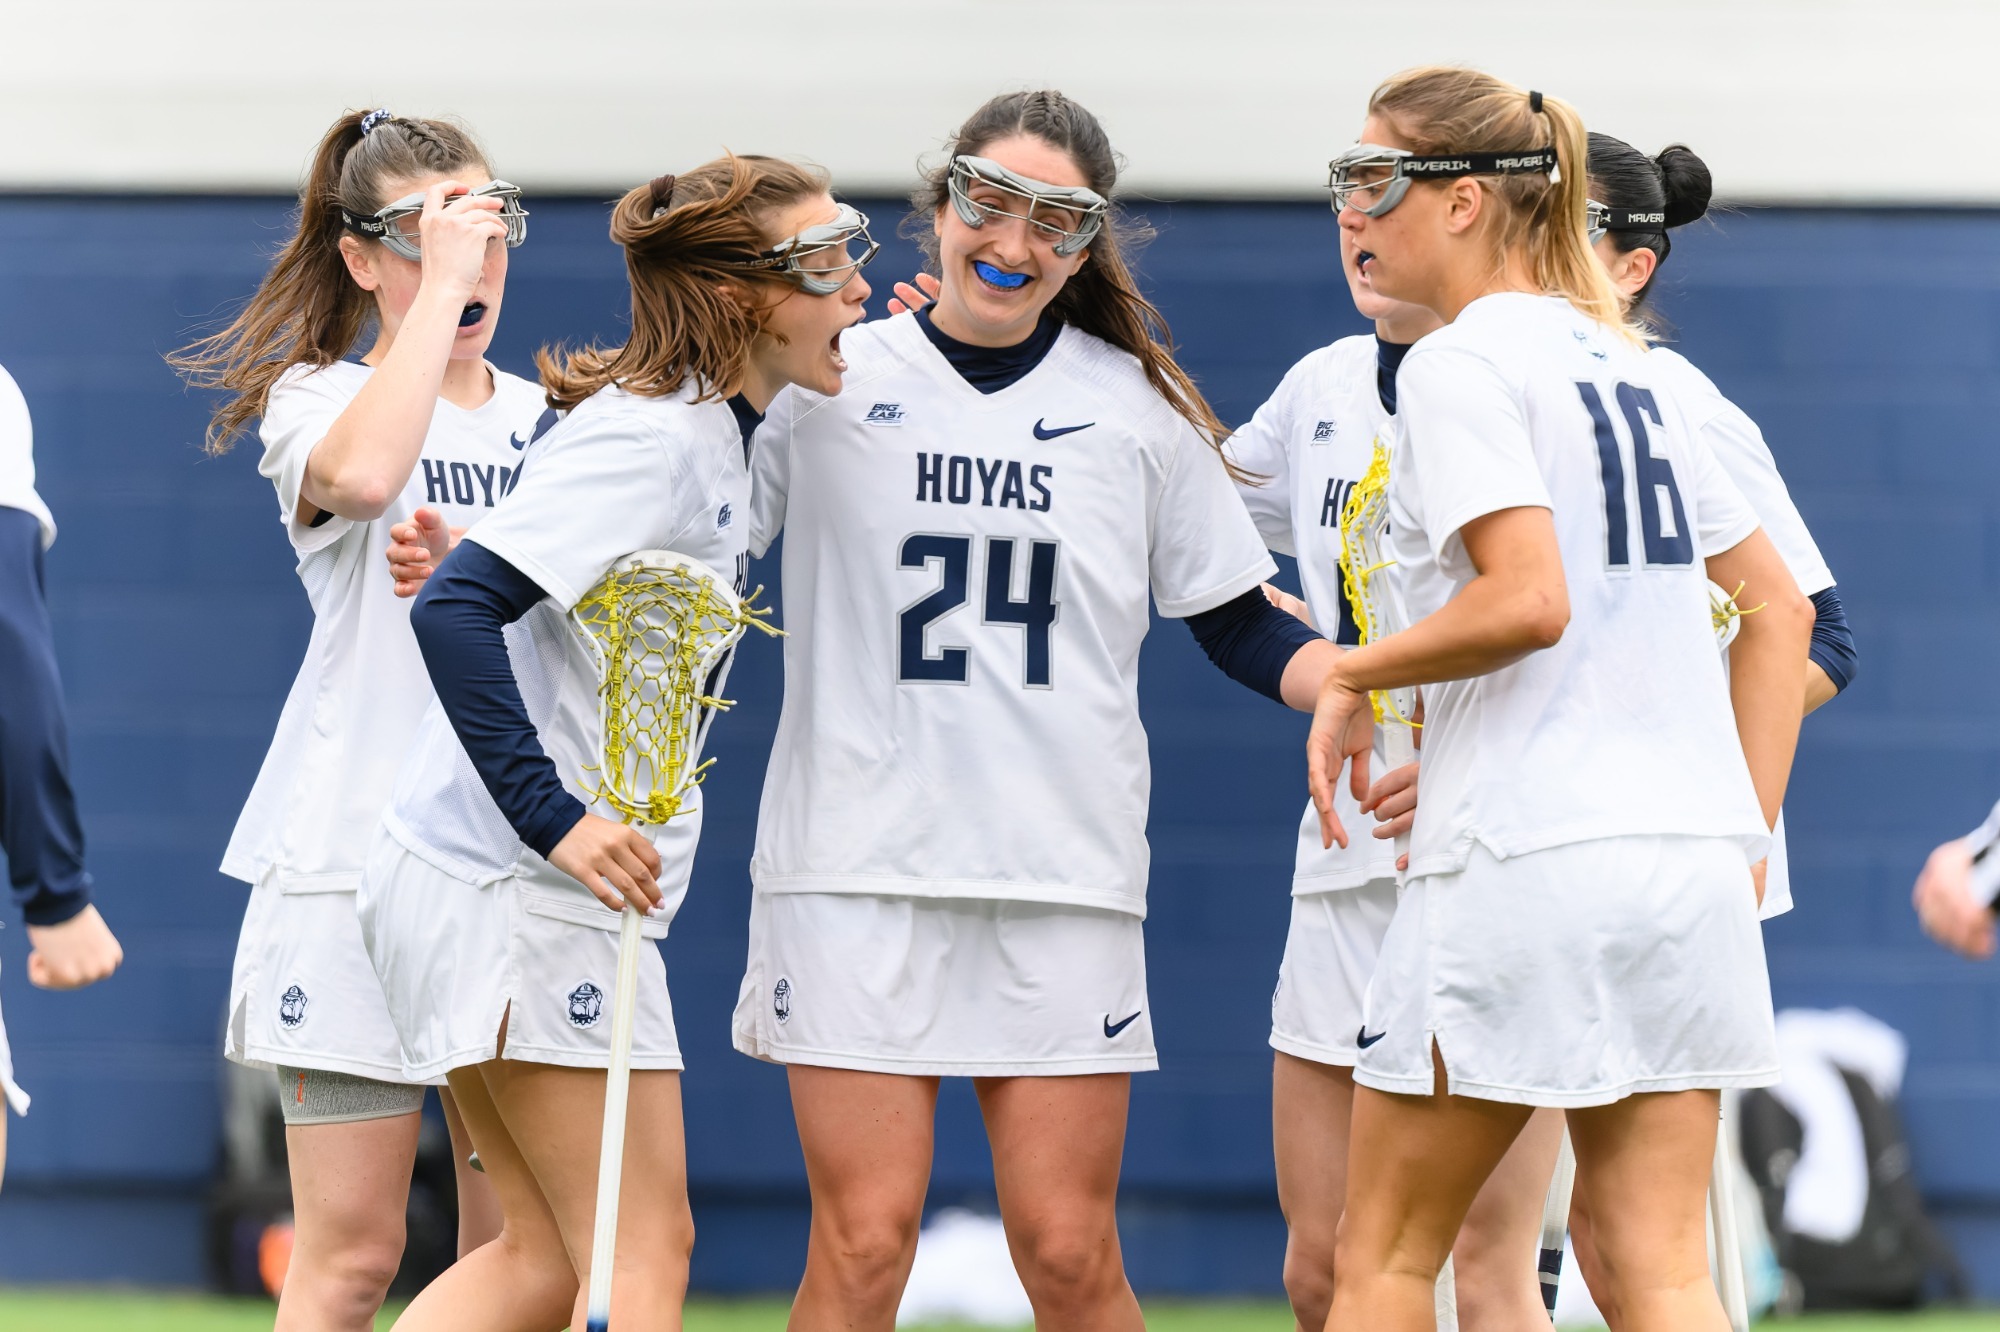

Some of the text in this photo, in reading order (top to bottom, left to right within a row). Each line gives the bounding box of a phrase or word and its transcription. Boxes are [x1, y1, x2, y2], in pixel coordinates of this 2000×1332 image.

[872, 403, 900, 411] BIG
[867, 411, 906, 419] EAST
[1317, 421, 1333, 429] BIG
[1314, 429, 1335, 437] EAST
[1570, 378, 1695, 571] 16
[916, 452, 1053, 513] HOYAS
[896, 531, 1061, 690] 24
